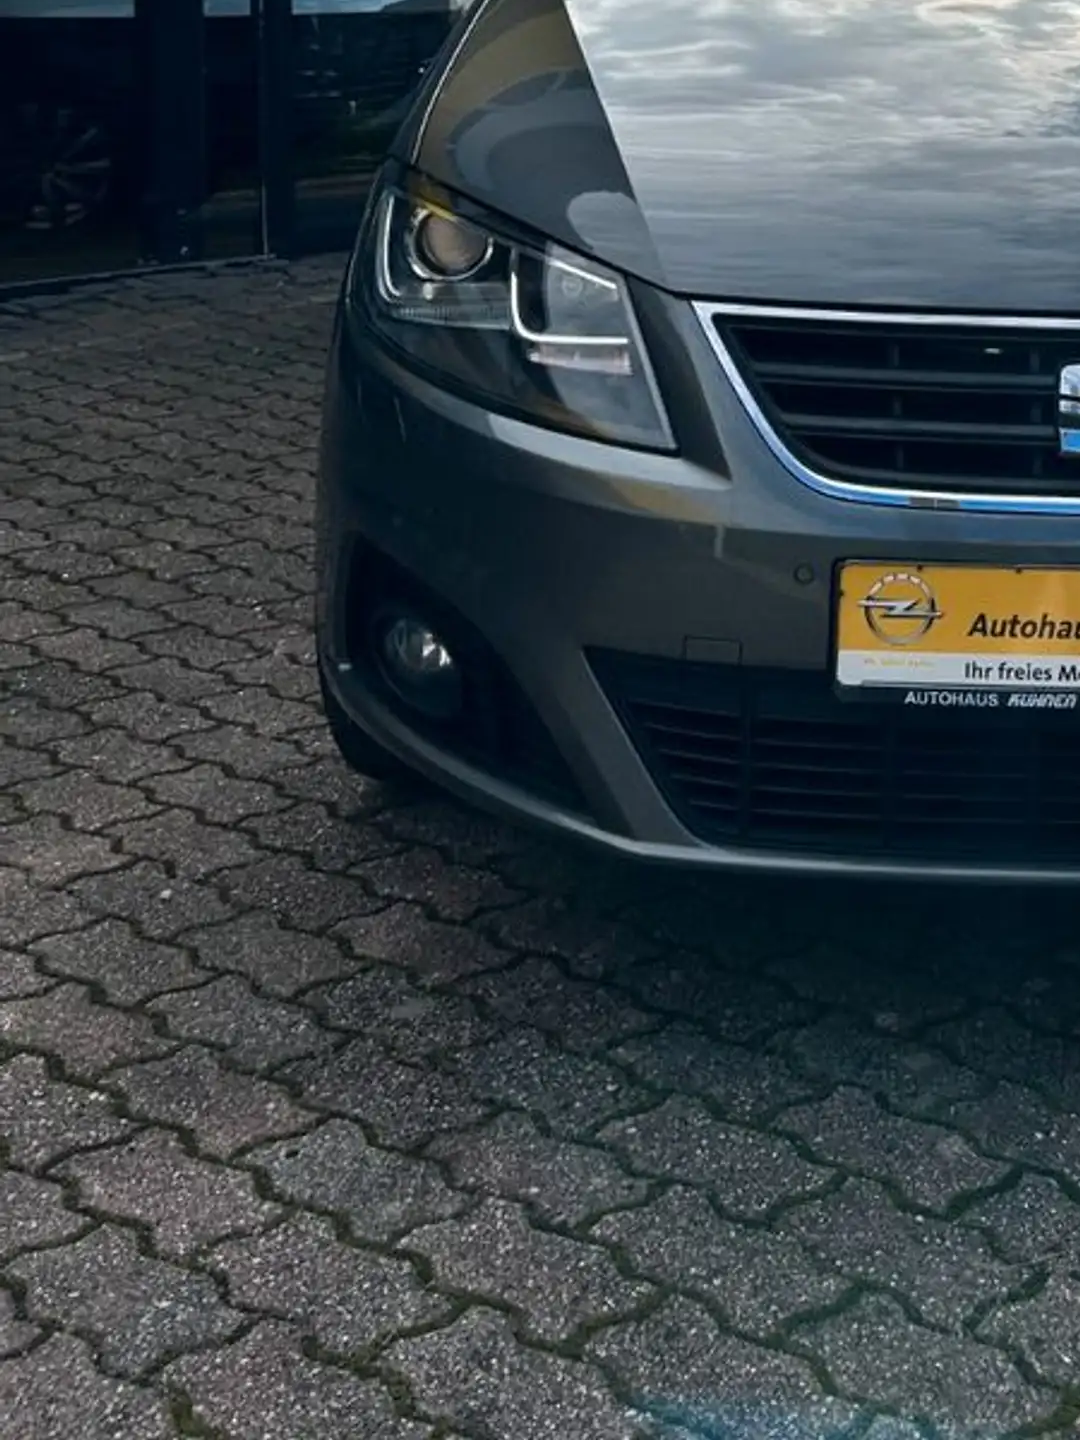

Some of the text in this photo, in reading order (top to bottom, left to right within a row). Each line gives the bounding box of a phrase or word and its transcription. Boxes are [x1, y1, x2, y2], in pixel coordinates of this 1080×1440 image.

[964, 661, 994, 682] Ihr
[998, 662, 1053, 683] freies
[904, 690, 999, 707] AUTOHAUS
